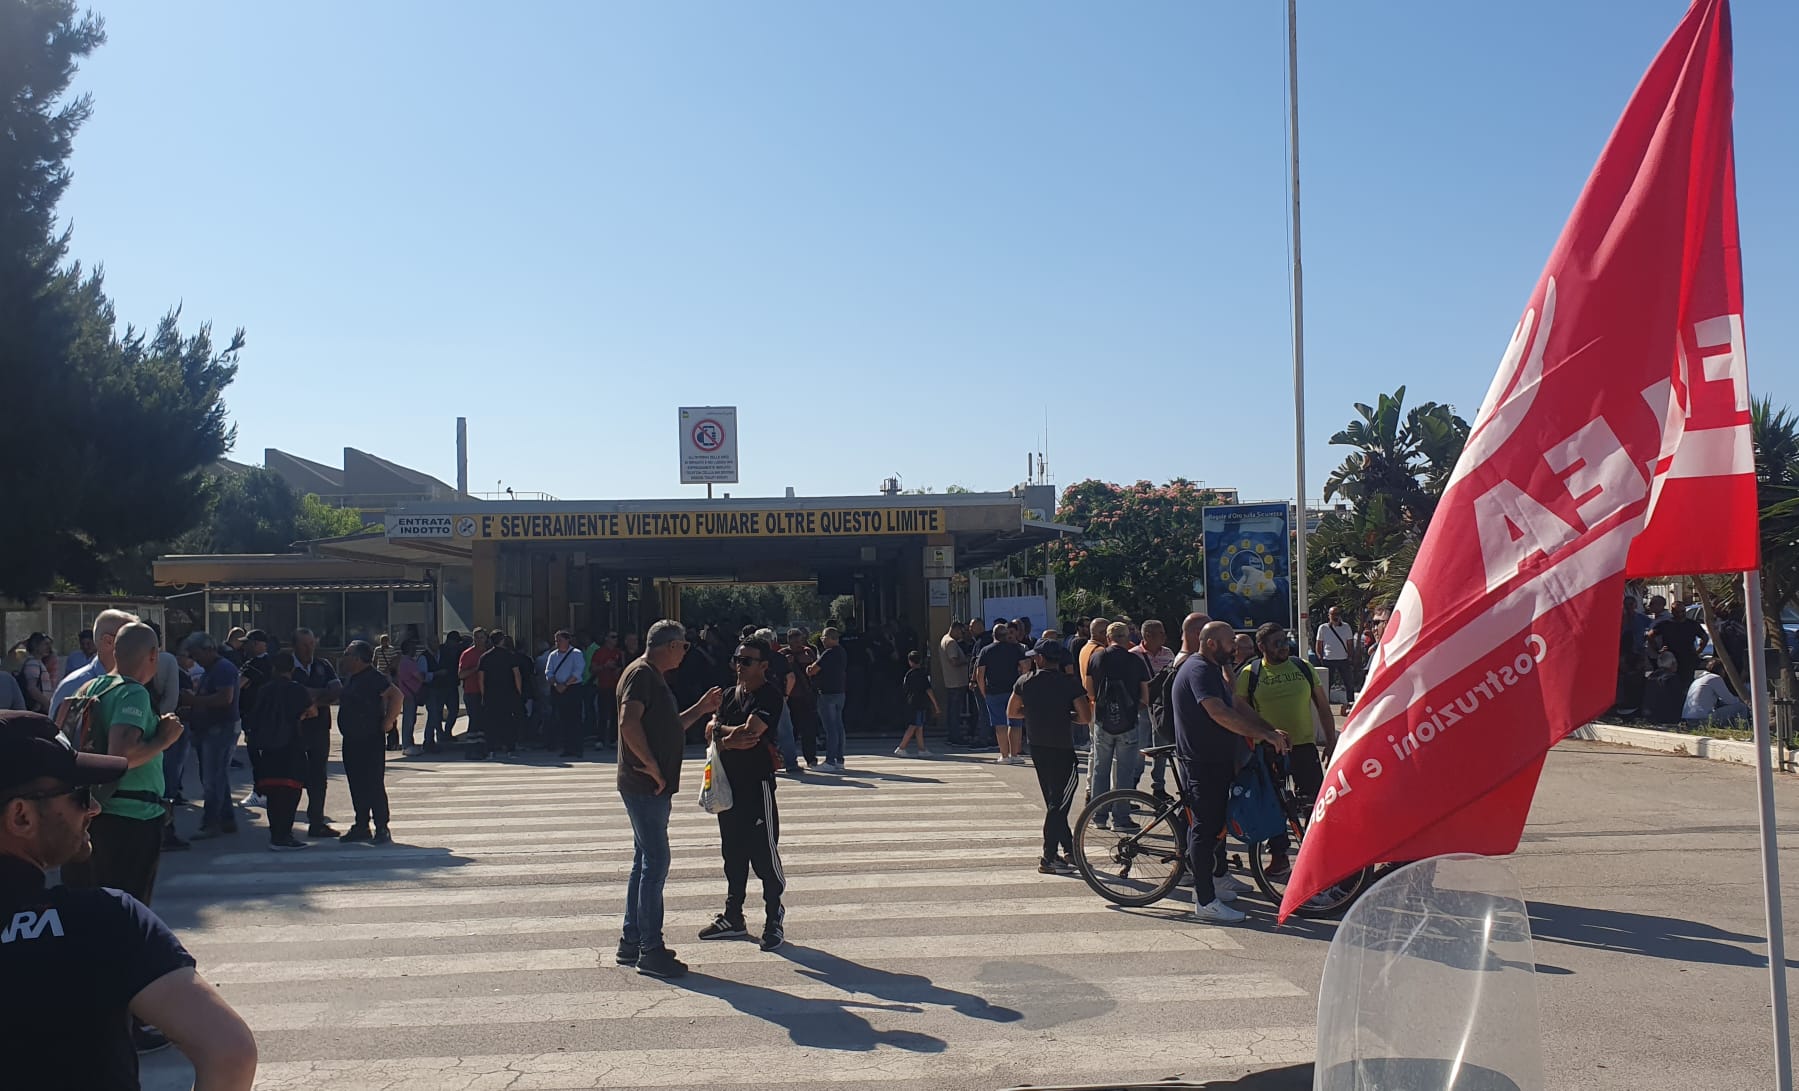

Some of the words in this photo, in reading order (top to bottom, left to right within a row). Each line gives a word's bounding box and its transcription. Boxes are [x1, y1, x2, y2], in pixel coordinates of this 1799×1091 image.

[399, 517, 452, 526] ENTRATA
[482, 515, 495, 538] E'
[500, 514, 620, 538] SEVERAMENTE
[625, 512, 692, 537] VIETATO
[696, 512, 760, 535] FUMARE
[765, 511, 816, 534] OLTRE
[820, 510, 882, 534] QUESTO
[887, 509, 938, 532] LIMITE
[400, 526, 451, 534] INDOTTO
